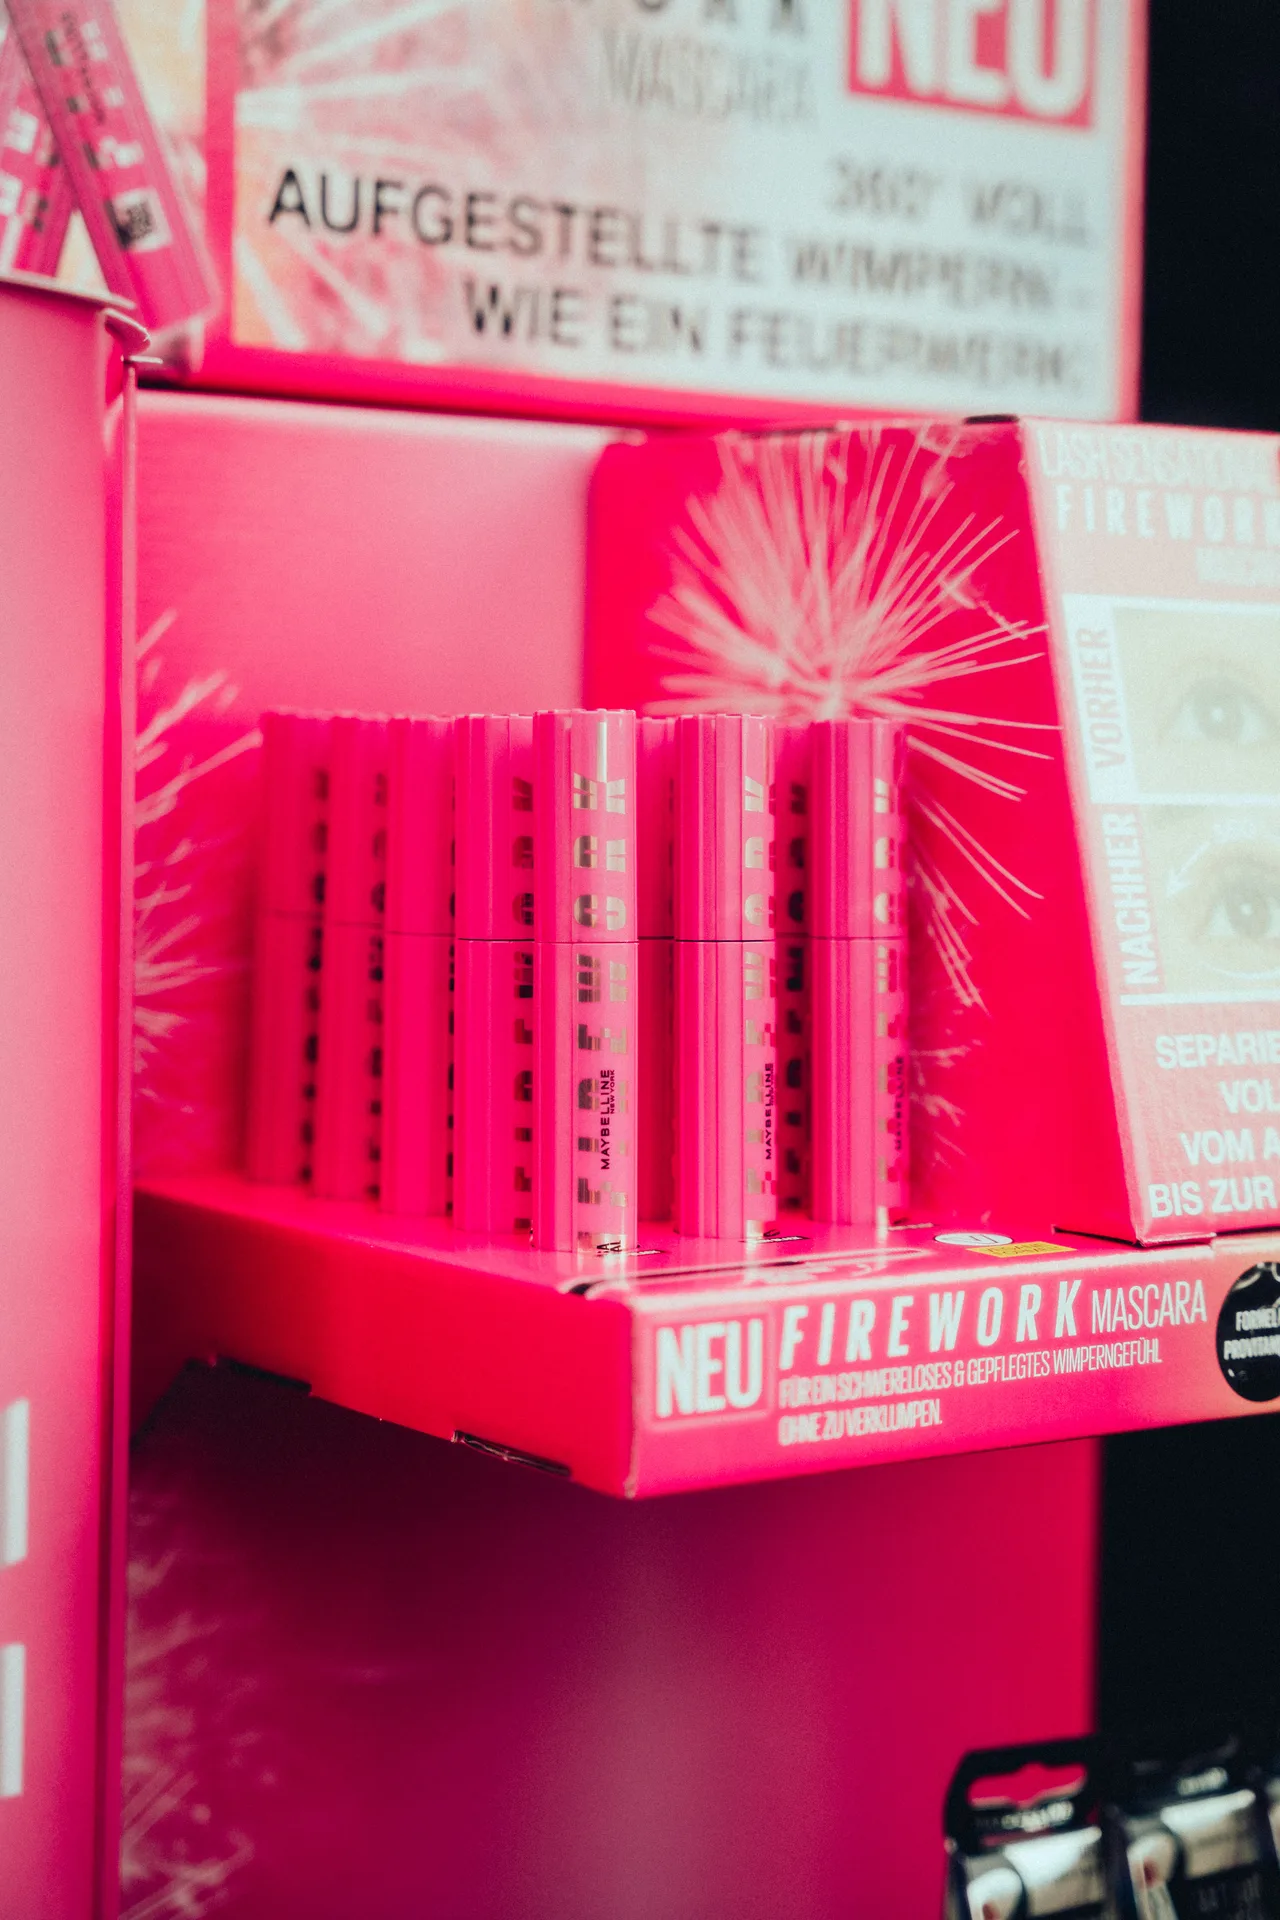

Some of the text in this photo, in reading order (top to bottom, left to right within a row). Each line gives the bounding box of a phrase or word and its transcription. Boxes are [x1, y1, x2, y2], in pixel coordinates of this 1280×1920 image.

[268, 168, 770, 283] AUFGESTELLTE
[465, 277, 582, 349] WIE
[608, 291, 707, 356] EIN
[1076, 626, 1126, 769] VORHER
[1101, 811, 1159, 985] NACHHER
[601, 1070, 610, 1169] MAYBELLINE
[765, 1063, 773, 1160] MAYBELLINE
[1180, 1128, 1255, 1166] VOM
[1148, 1175, 1277, 1218] BIS ZUR
[656, 1318, 763, 1418] NEU
[779, 1279, 1207, 1370] FIREWORK MASCARA
[837, 1360, 951, 1402] SCHWERELOSES
[953, 1358, 964, 1387] &
[967, 1351, 1050, 1385] GEPFLEGTES
[1053, 1338, 1162, 1375] WIMPERNGEFÜHL
[778, 1397, 943, 1446] OHNE ZU VERKLUMPEN.
